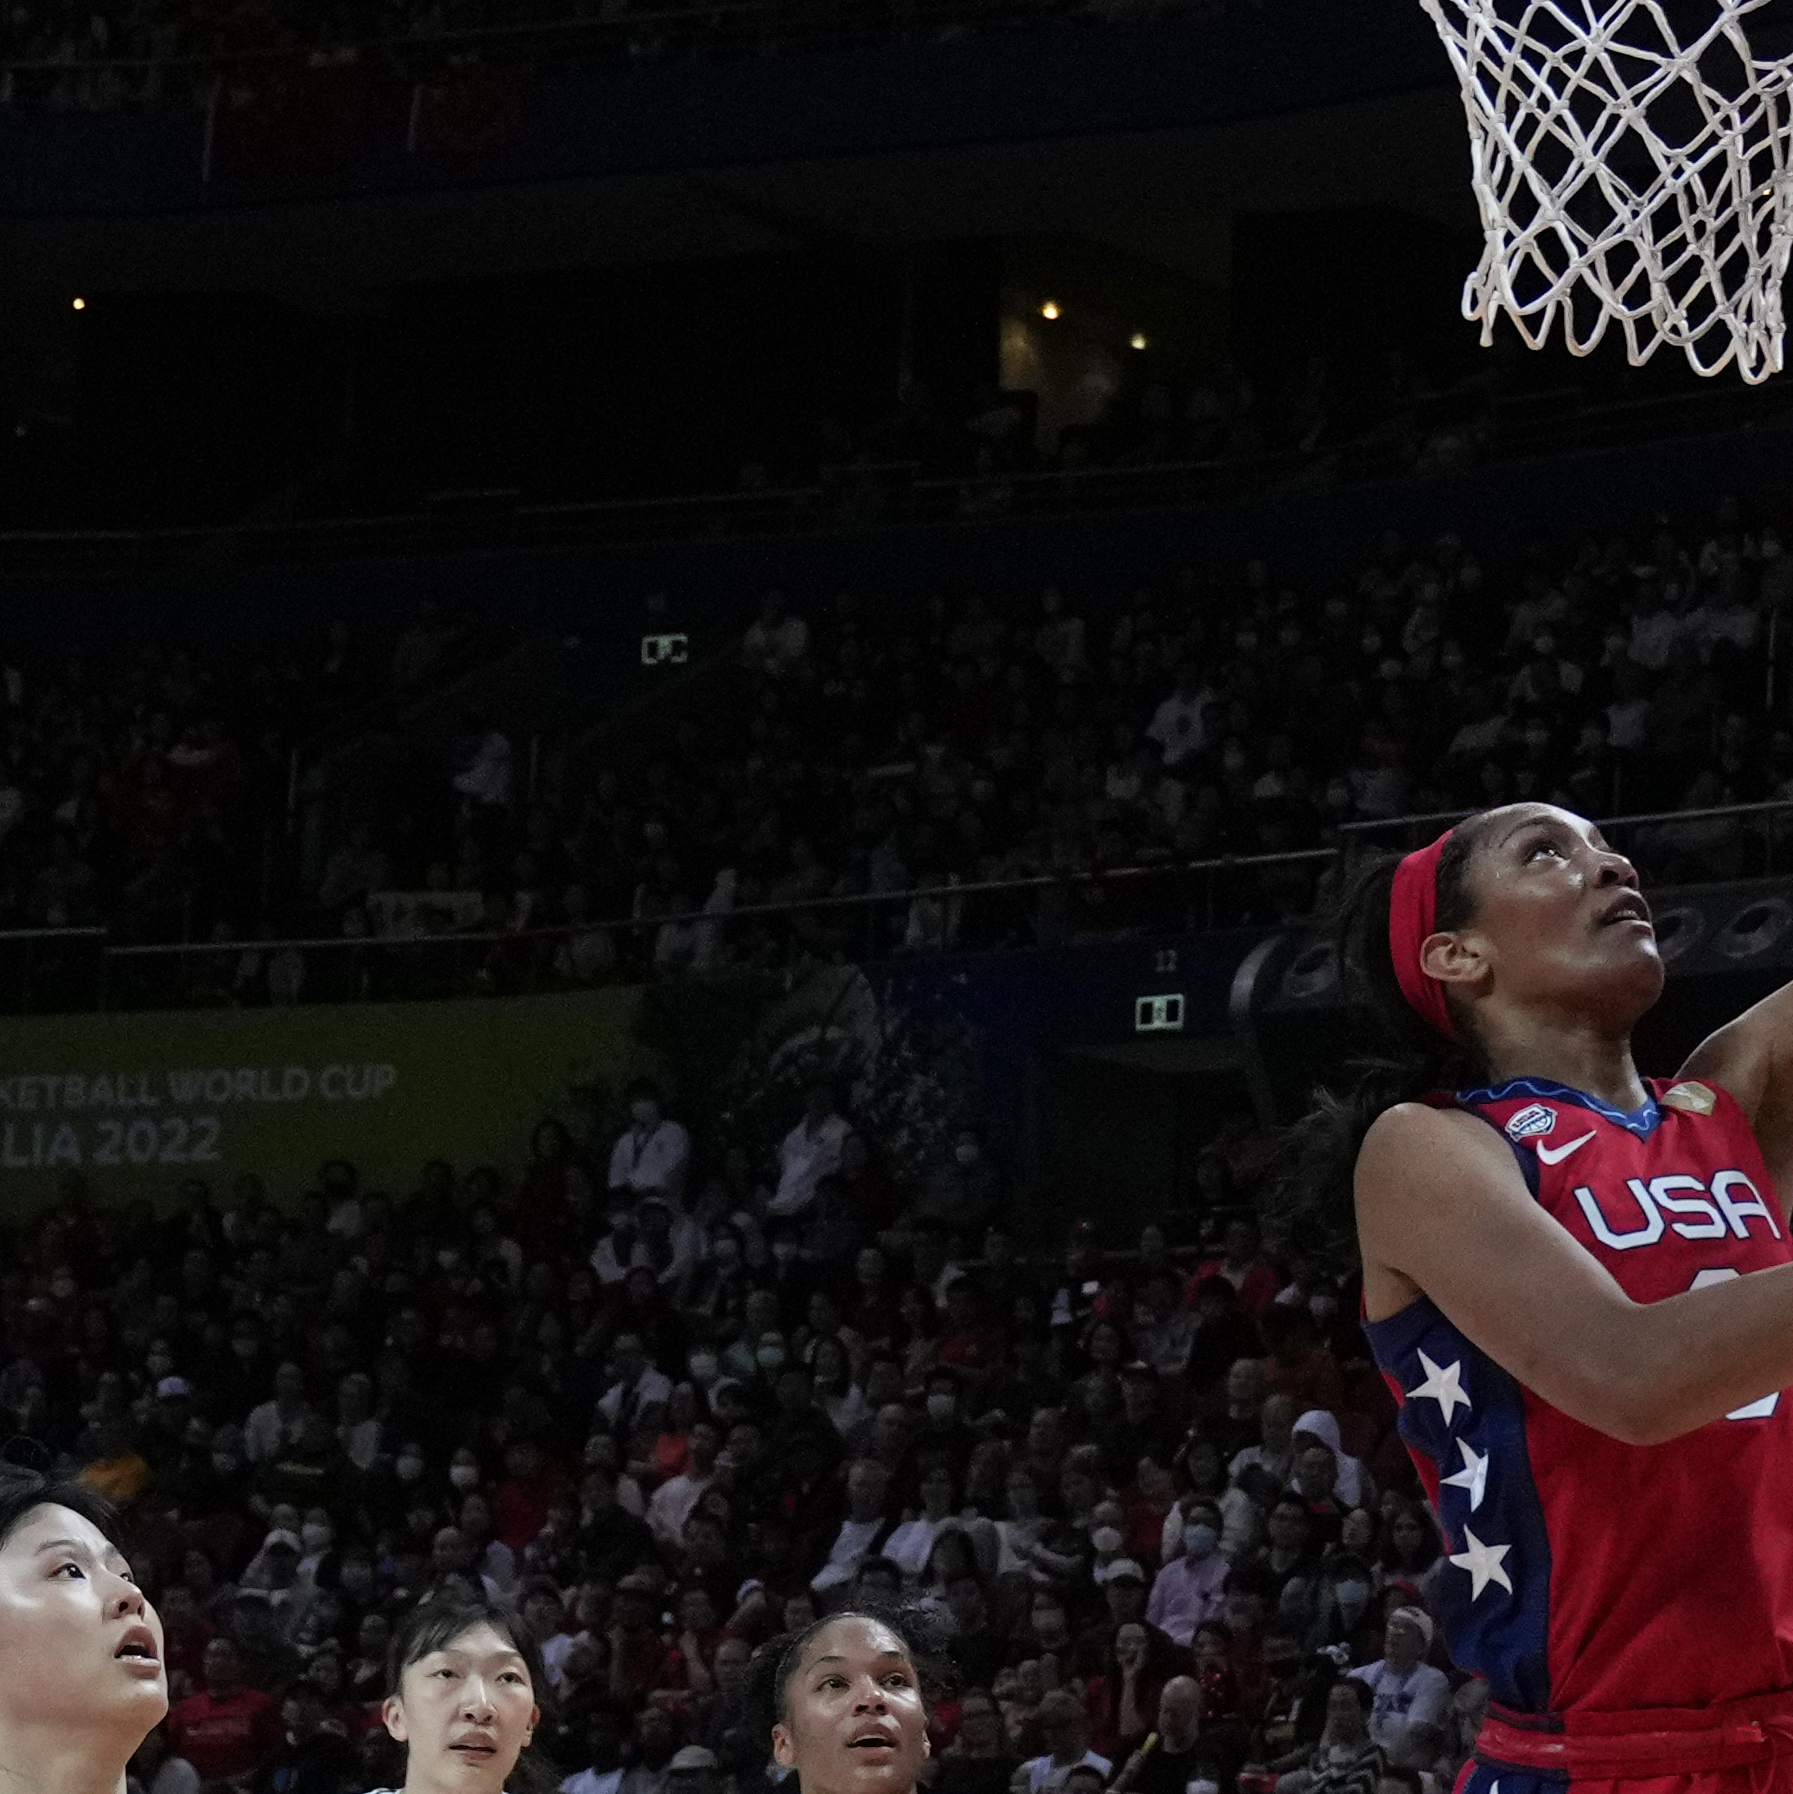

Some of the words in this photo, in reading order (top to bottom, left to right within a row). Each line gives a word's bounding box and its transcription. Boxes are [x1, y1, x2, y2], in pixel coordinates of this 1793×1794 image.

[167, 1064, 311, 1105] WORLD
[318, 1062, 397, 1100] CUP
[91, 1116, 225, 1164] 2022
[1572, 1168, 1783, 1250] USA
